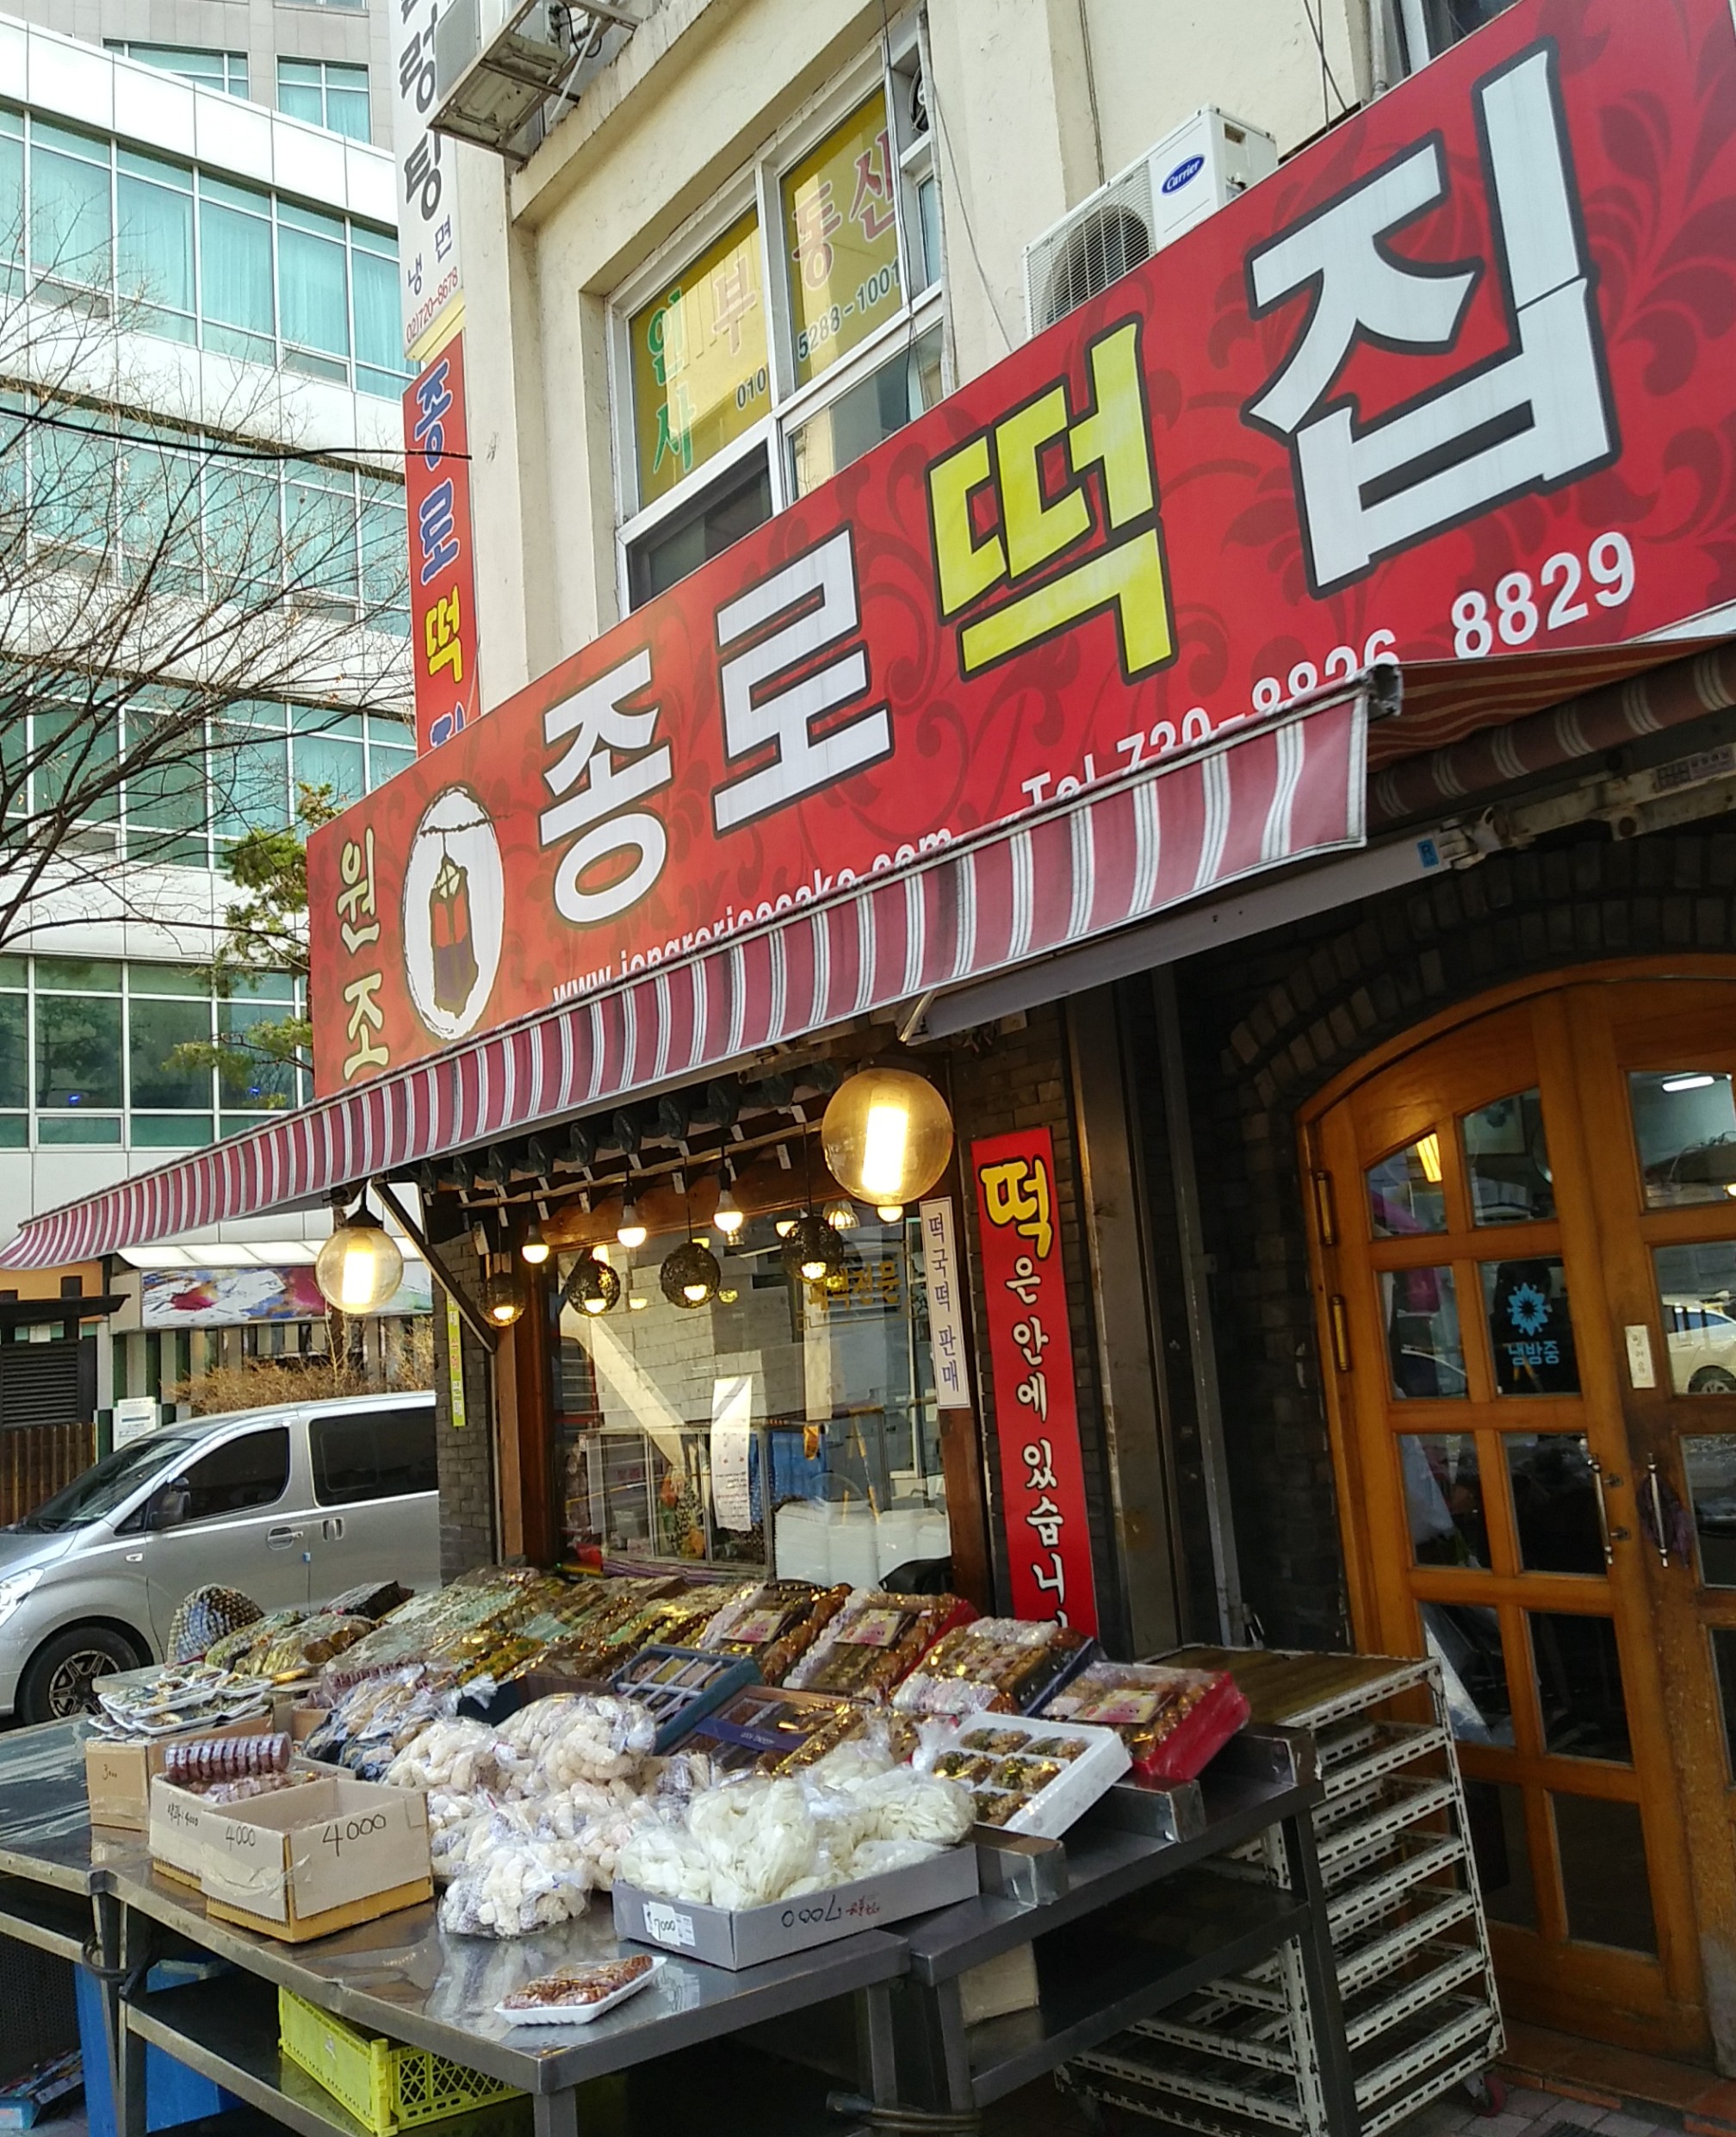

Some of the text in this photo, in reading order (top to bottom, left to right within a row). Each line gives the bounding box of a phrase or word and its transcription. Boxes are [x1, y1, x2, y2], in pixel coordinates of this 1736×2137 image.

[399, 0, 442, 221] 렁탕
[1166, 158, 1200, 191] Carrier
[406, 266, 458, 344] 02)720-8678
[736, 367, 766, 409] 010
[1451, 531, 1636, 660] 8829
[336, 827, 389, 1081] 원조
[928, 1212, 960, 1392] 떡국떡 판매
[1508, 1339, 1560, 1365] 냉방중
[225, 1825, 256, 1852] 4000
[322, 1813, 387, 1857] 4000
[653, 1917, 676, 1940] 7000
